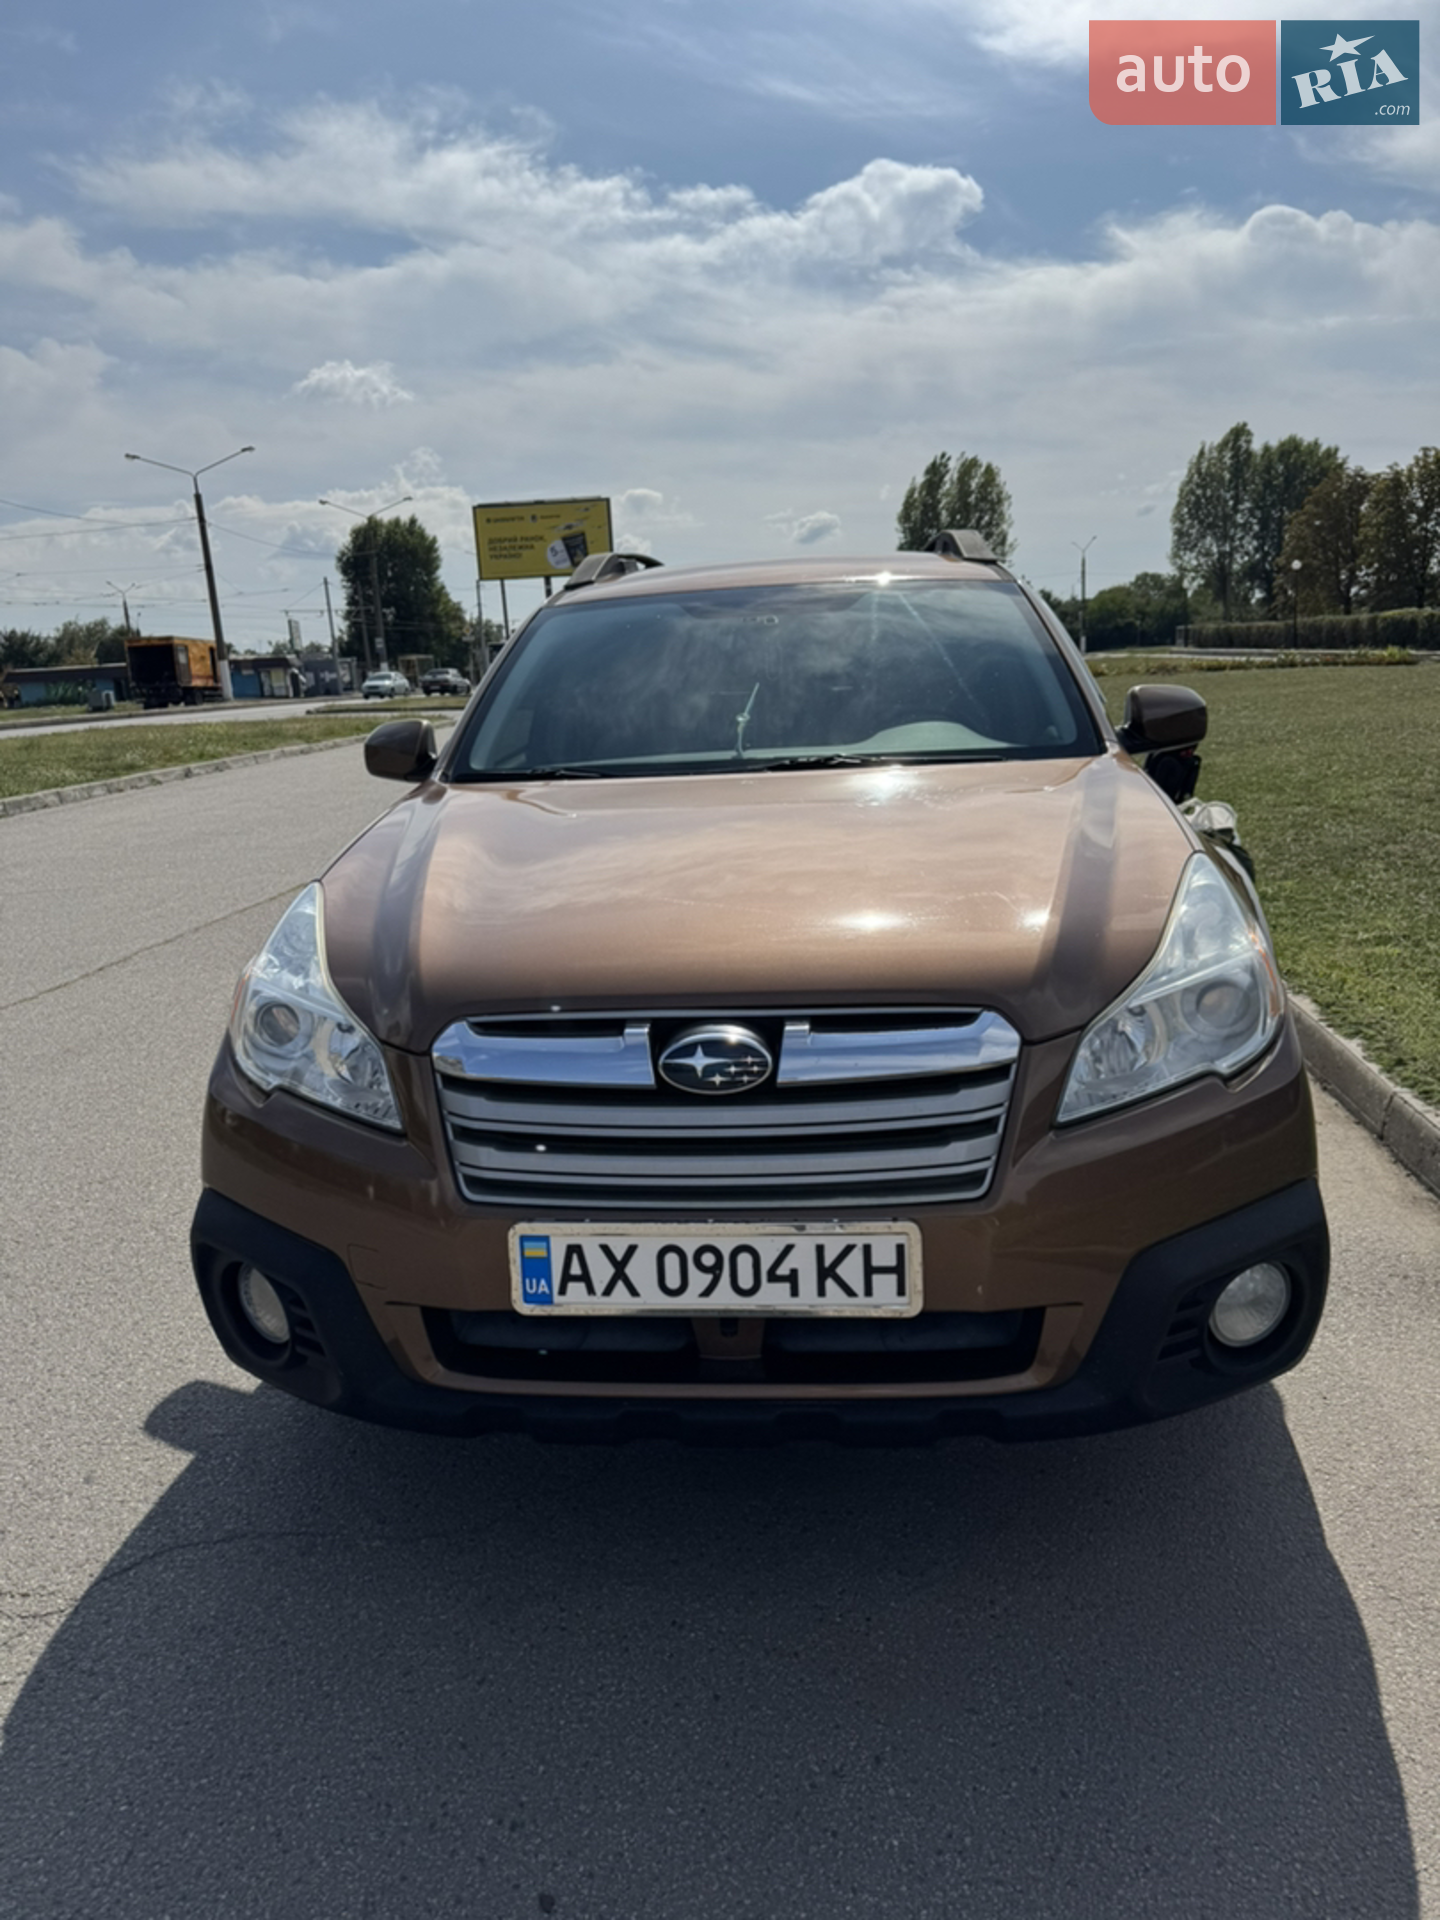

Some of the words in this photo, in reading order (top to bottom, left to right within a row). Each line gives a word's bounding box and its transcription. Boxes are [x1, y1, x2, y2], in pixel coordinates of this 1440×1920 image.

[526, 1278, 549, 1295] UA
[557, 1243, 641, 1298] AX
[656, 1243, 800, 1298] 0904
[815, 1243, 907, 1298] KH
